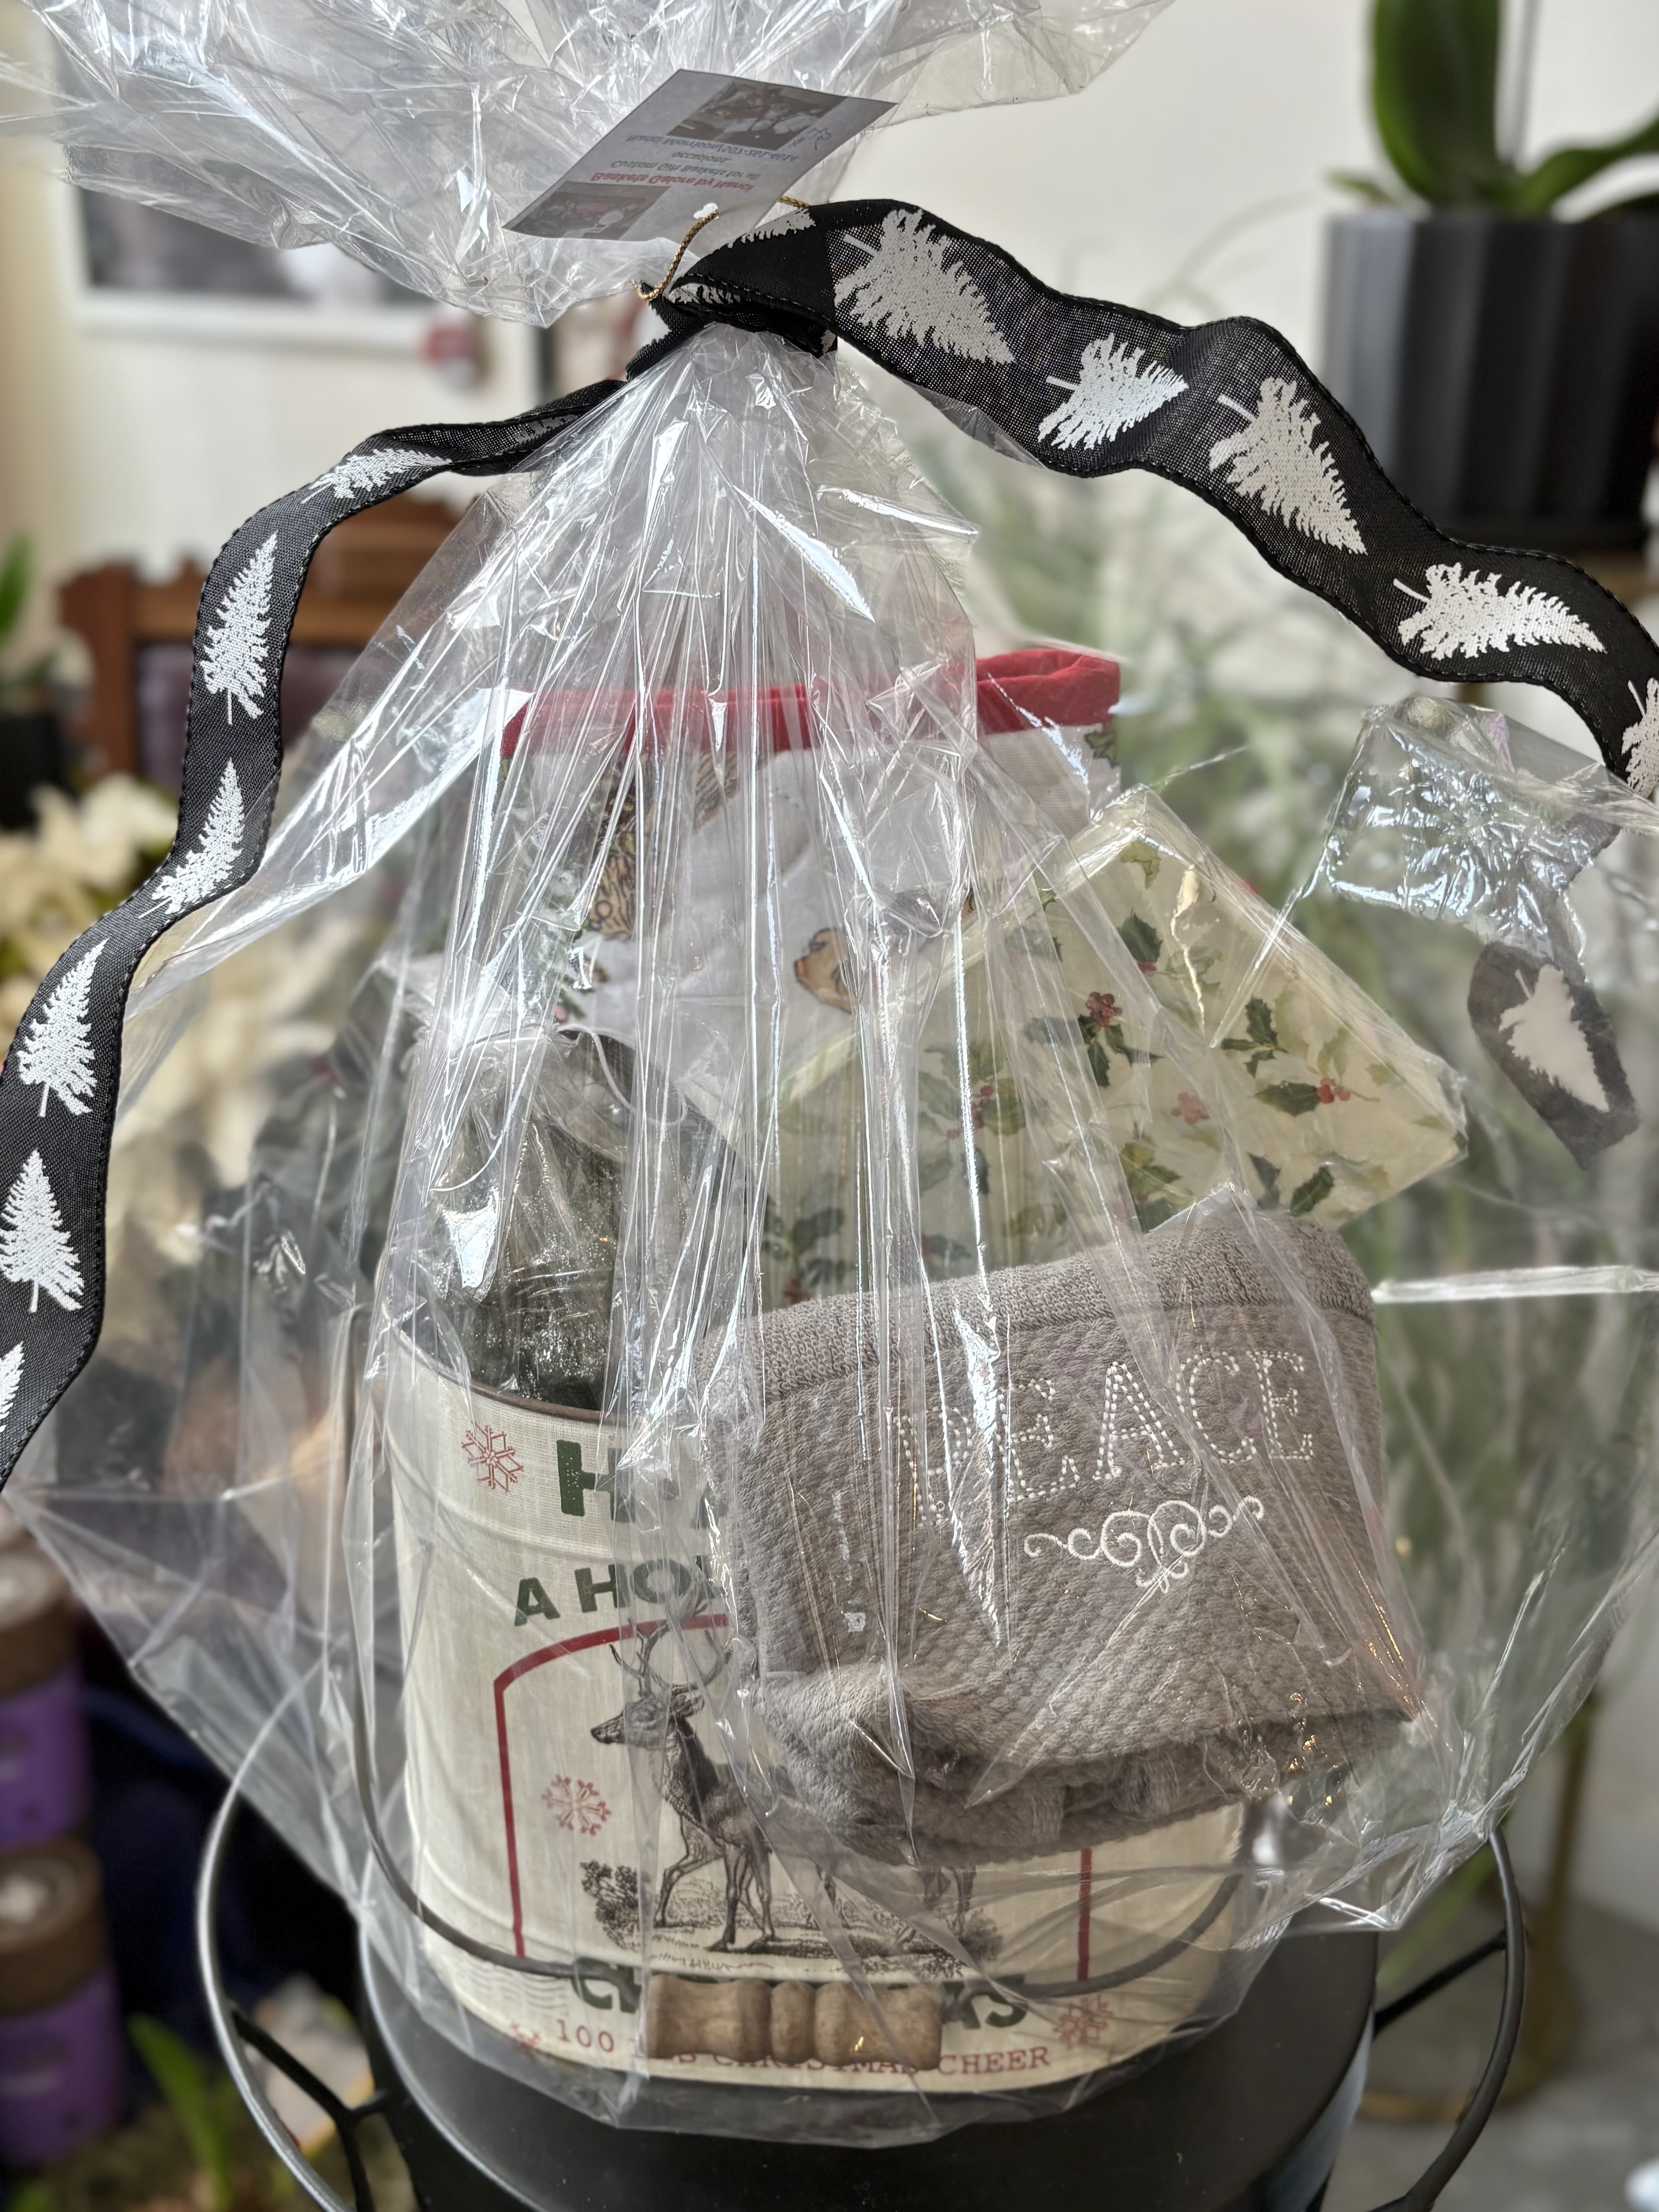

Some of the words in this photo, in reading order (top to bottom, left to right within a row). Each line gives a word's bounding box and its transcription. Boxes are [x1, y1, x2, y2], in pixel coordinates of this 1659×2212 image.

[514, 1576, 560, 1626] A
[557, 2019, 615, 2053] 100
[938, 2046, 1051, 2075] CHEER
